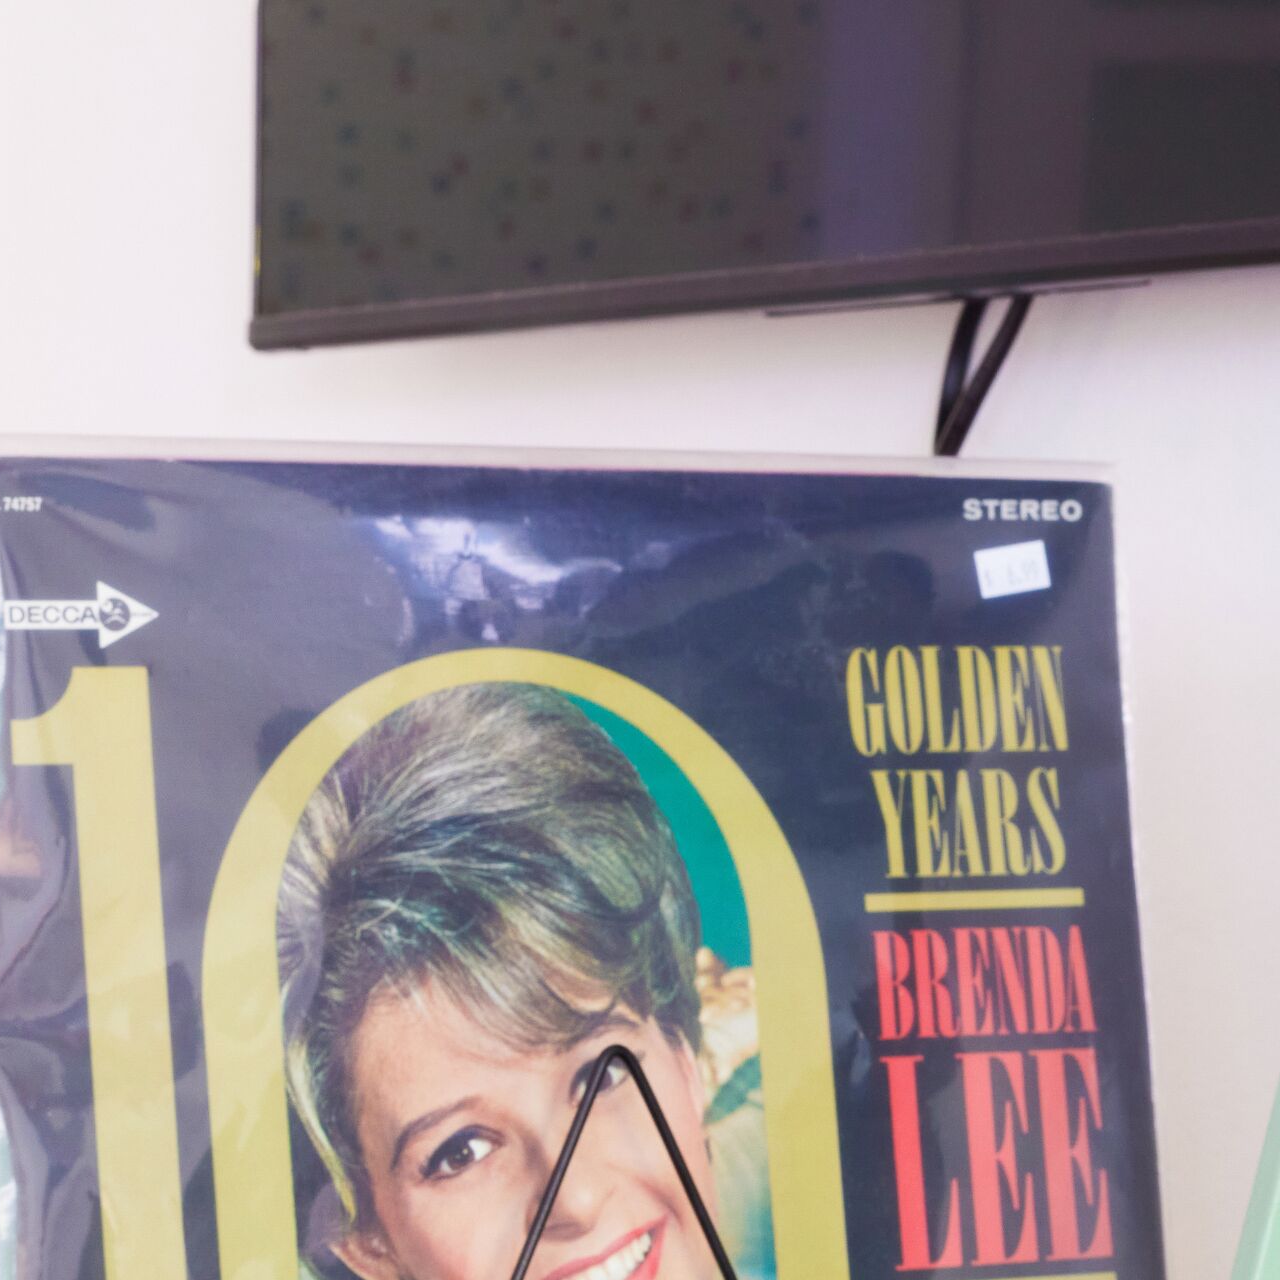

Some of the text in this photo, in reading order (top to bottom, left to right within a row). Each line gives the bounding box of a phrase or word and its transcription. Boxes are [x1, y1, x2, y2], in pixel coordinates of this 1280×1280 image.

[962, 497, 1084, 522] STEREO
[8, 605, 98, 625] DECCA
[846, 645, 1069, 758] GOLDEN
[870, 766, 1067, 879] YEARS
[872, 924, 1098, 1041] BRENDA
[878, 1046, 1114, 1272] LEE
